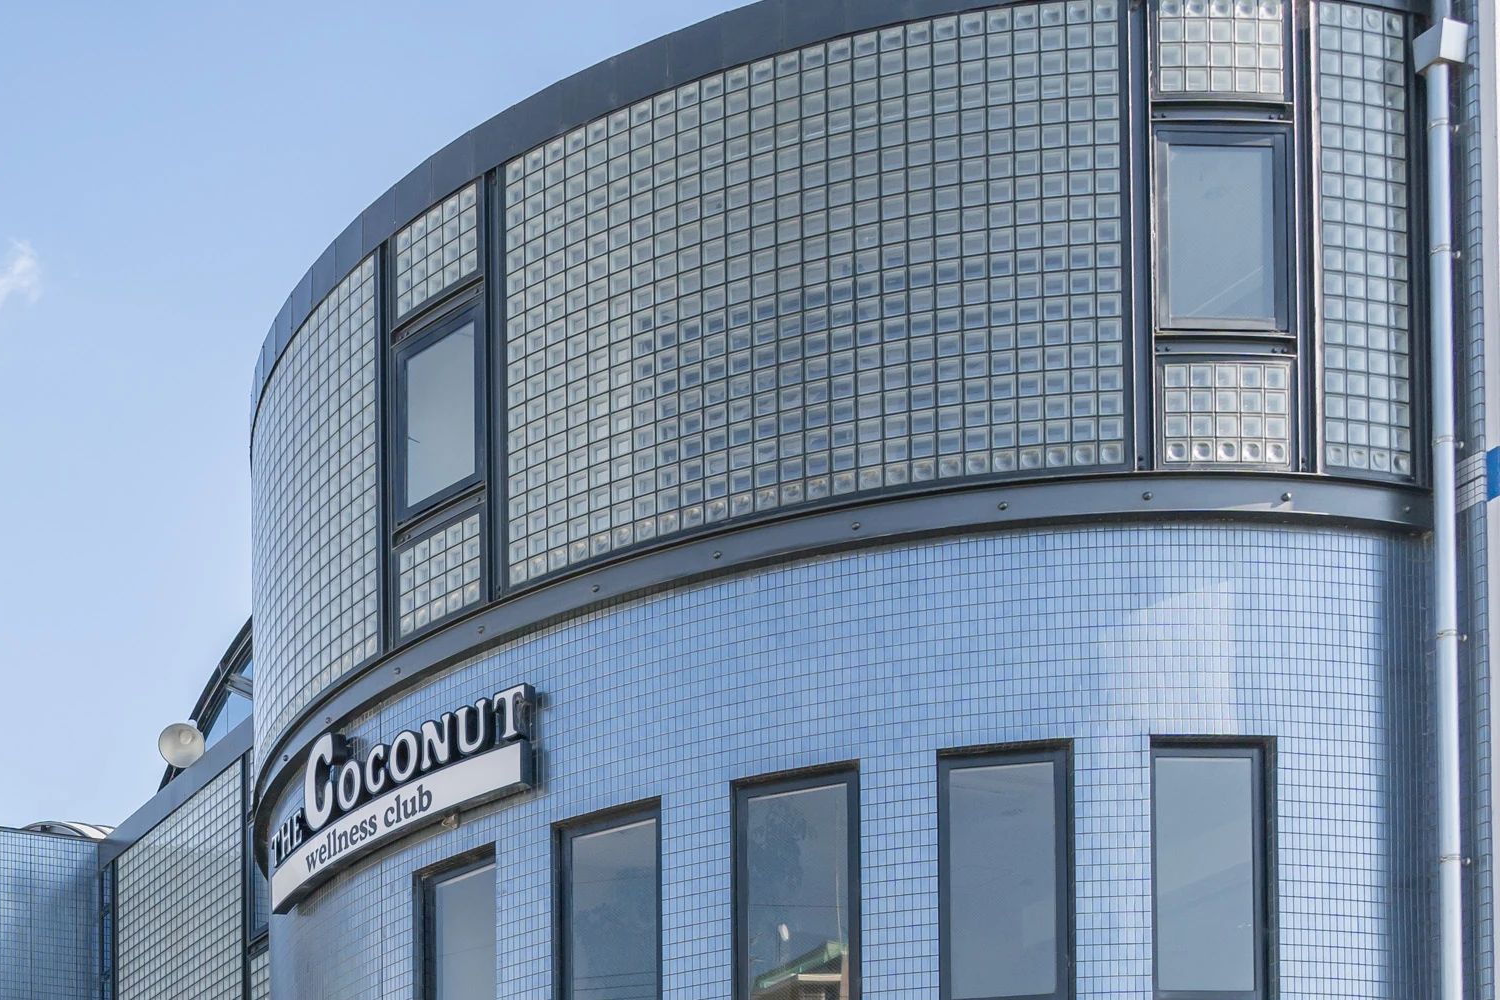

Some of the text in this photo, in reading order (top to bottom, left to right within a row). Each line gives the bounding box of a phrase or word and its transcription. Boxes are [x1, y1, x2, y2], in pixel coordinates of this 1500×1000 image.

[271, 684, 535, 868] THE COCONUT
[305, 785, 434, 873] wellness club
